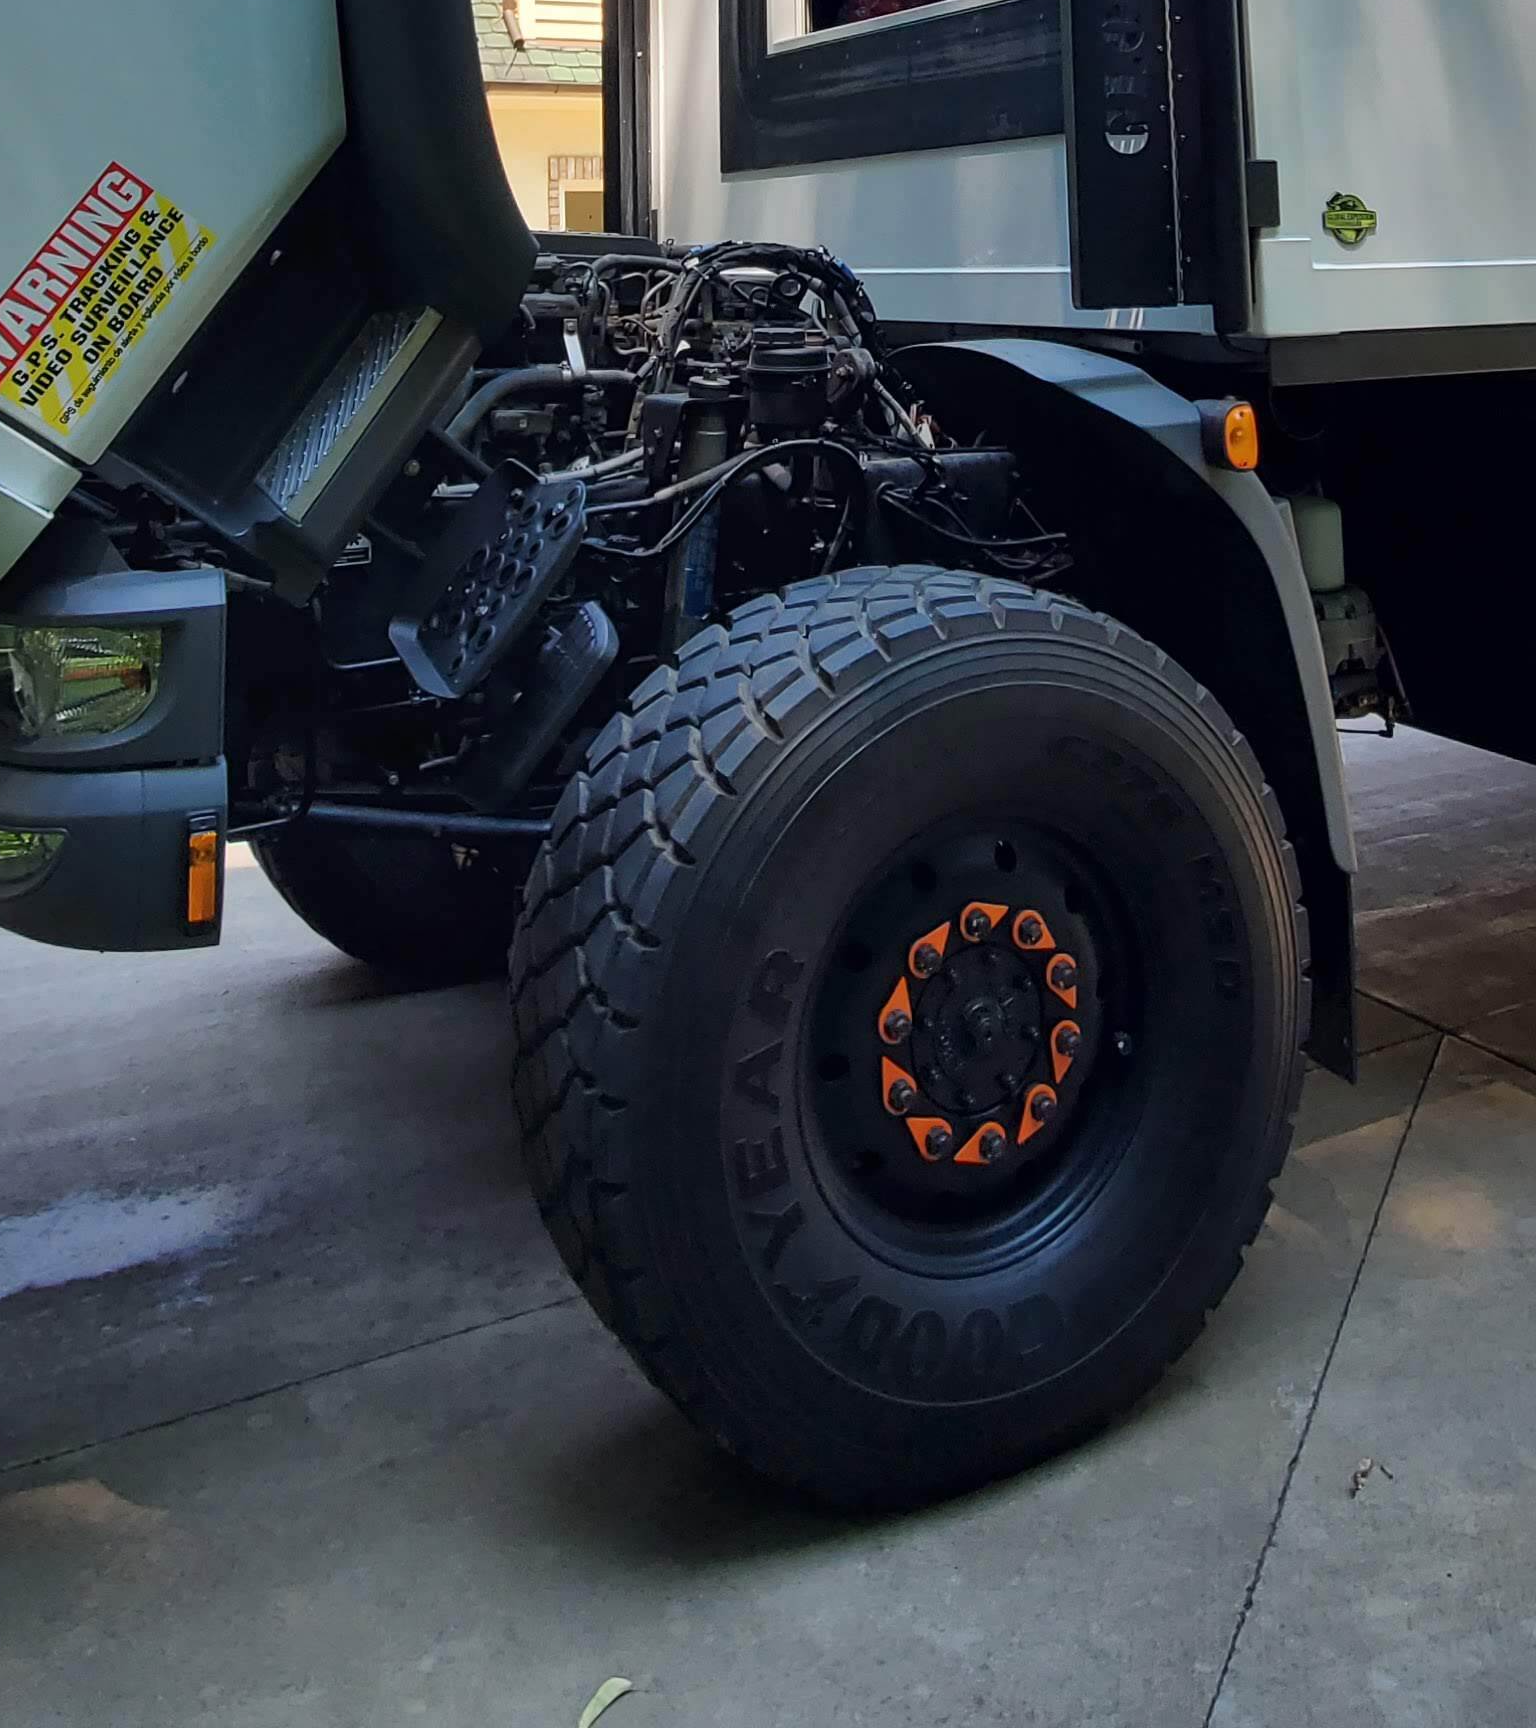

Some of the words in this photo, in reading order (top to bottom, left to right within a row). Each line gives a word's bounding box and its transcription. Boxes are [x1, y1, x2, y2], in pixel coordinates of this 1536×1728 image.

[11, 333, 66, 387] G.P.S.
[59, 228, 142, 324] TRACKING
[139, 209, 162, 227] &
[19, 348, 73, 408] VIDEO
[70, 207, 185, 347] SURVEILLANCE
[59, 406, 77, 424] GPS
[74, 397, 84, 408] de
[113, 347, 123, 358] de
[190, 236, 209, 258] bordo
[83, 334, 112, 365] ON
[107, 265, 164, 334] BOARD
[733, 948, 1070, 1379] GOODYEAR
